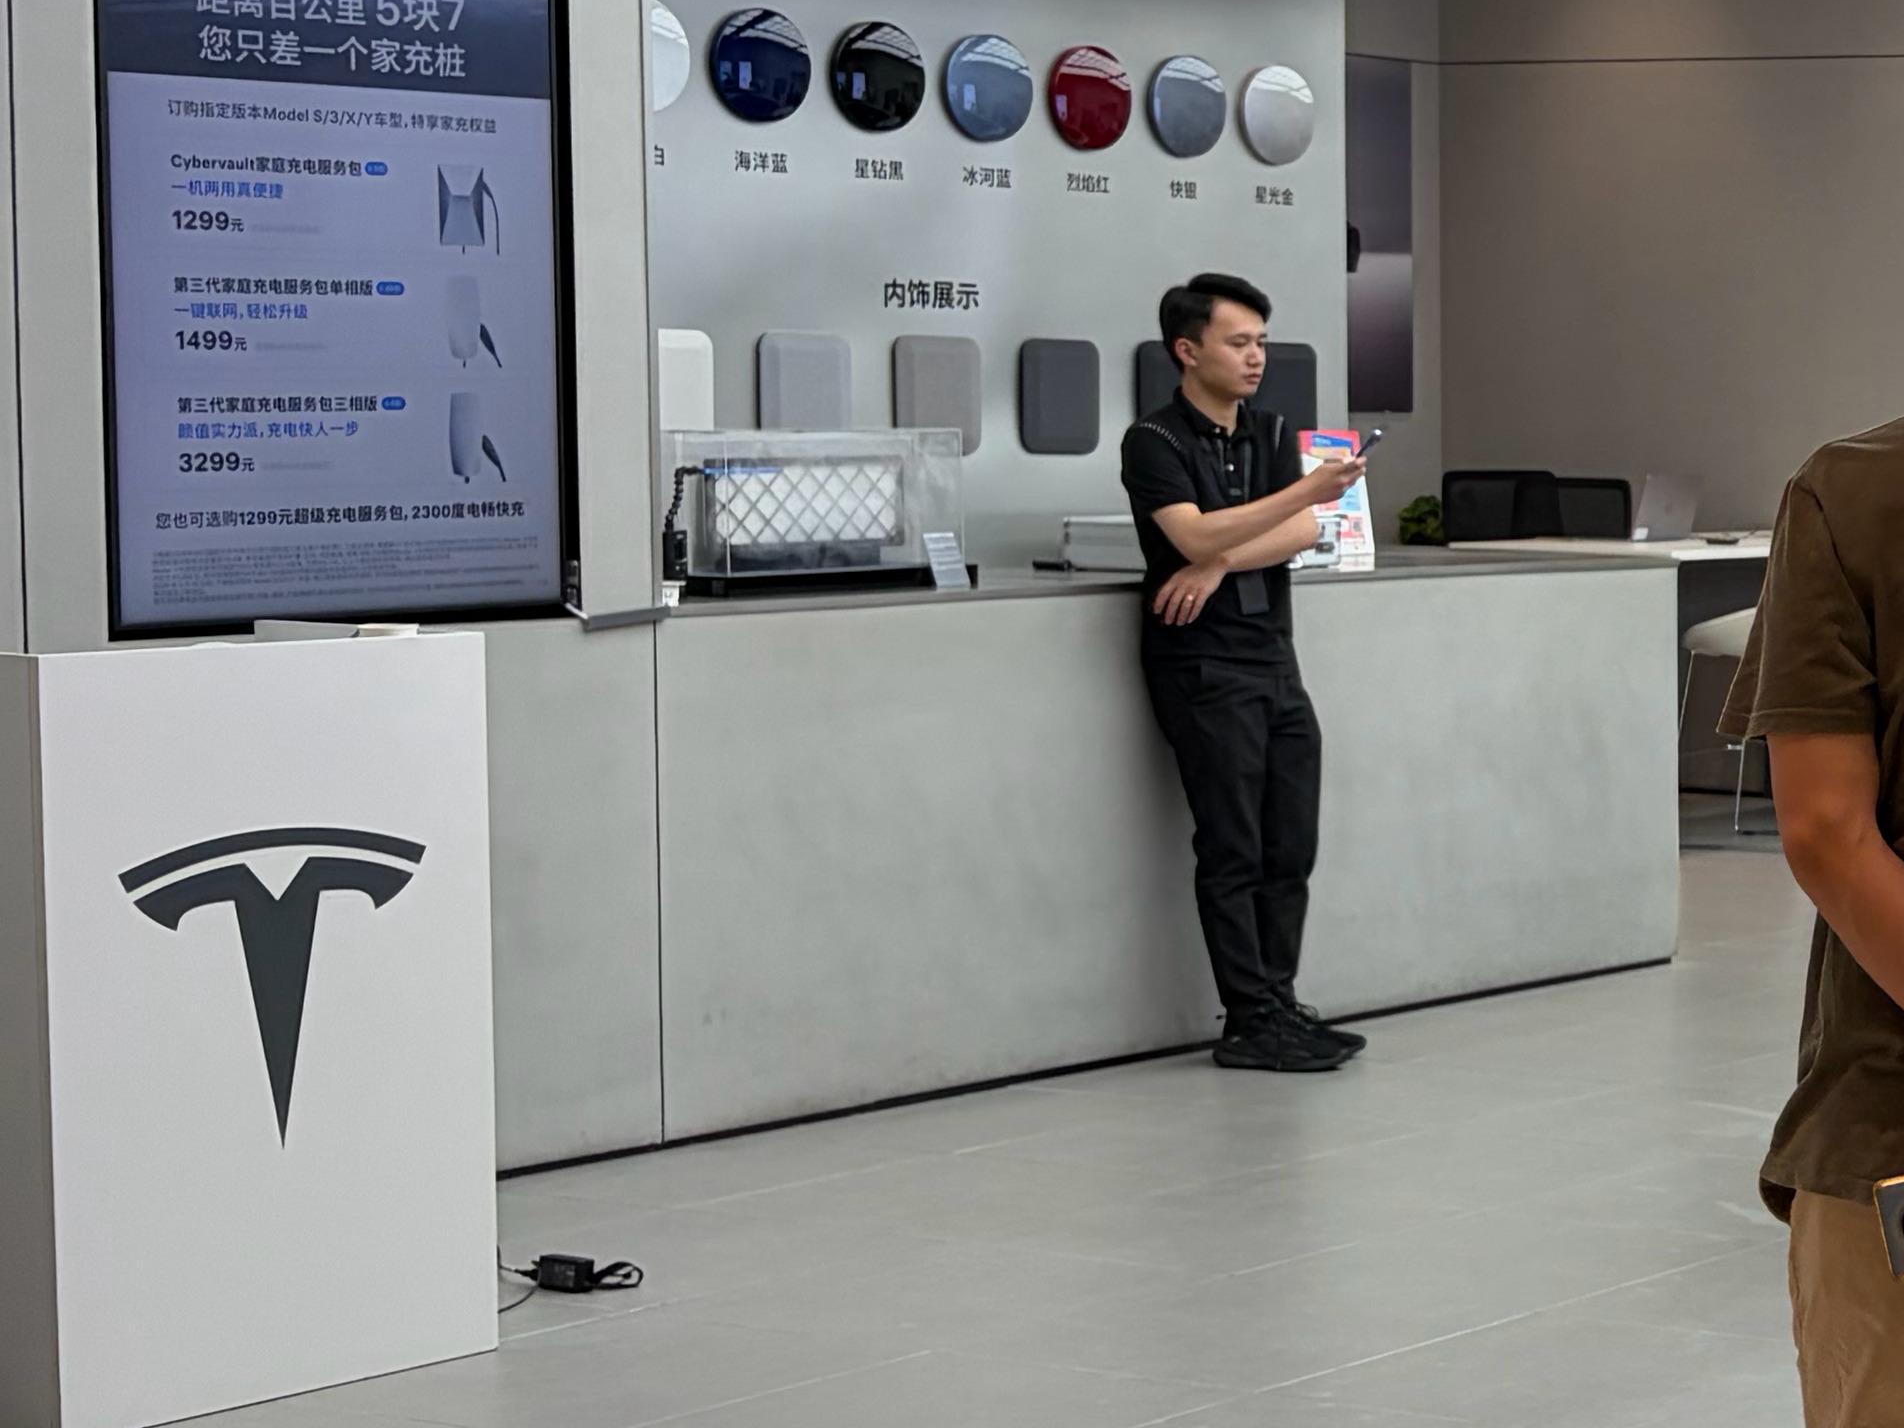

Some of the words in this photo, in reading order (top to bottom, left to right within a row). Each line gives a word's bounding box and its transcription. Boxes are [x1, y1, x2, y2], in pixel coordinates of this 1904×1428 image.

[199, 25, 466, 78] 您只差一个家充桩
[734, 150, 788, 173] 海洋蓝
[855, 158, 904, 181] 星钻黑
[962, 166, 1012, 189] 冰河蓝
[1066, 172, 1110, 194] 烈焰红
[1170, 179, 1198, 200] 快银
[1255, 185, 1294, 206] 星光金
[171, 209, 245, 232] 1299元
[883, 279, 980, 311] 内饰展示
[175, 330, 247, 352] 1499元
[179, 452, 255, 473] 3299元
